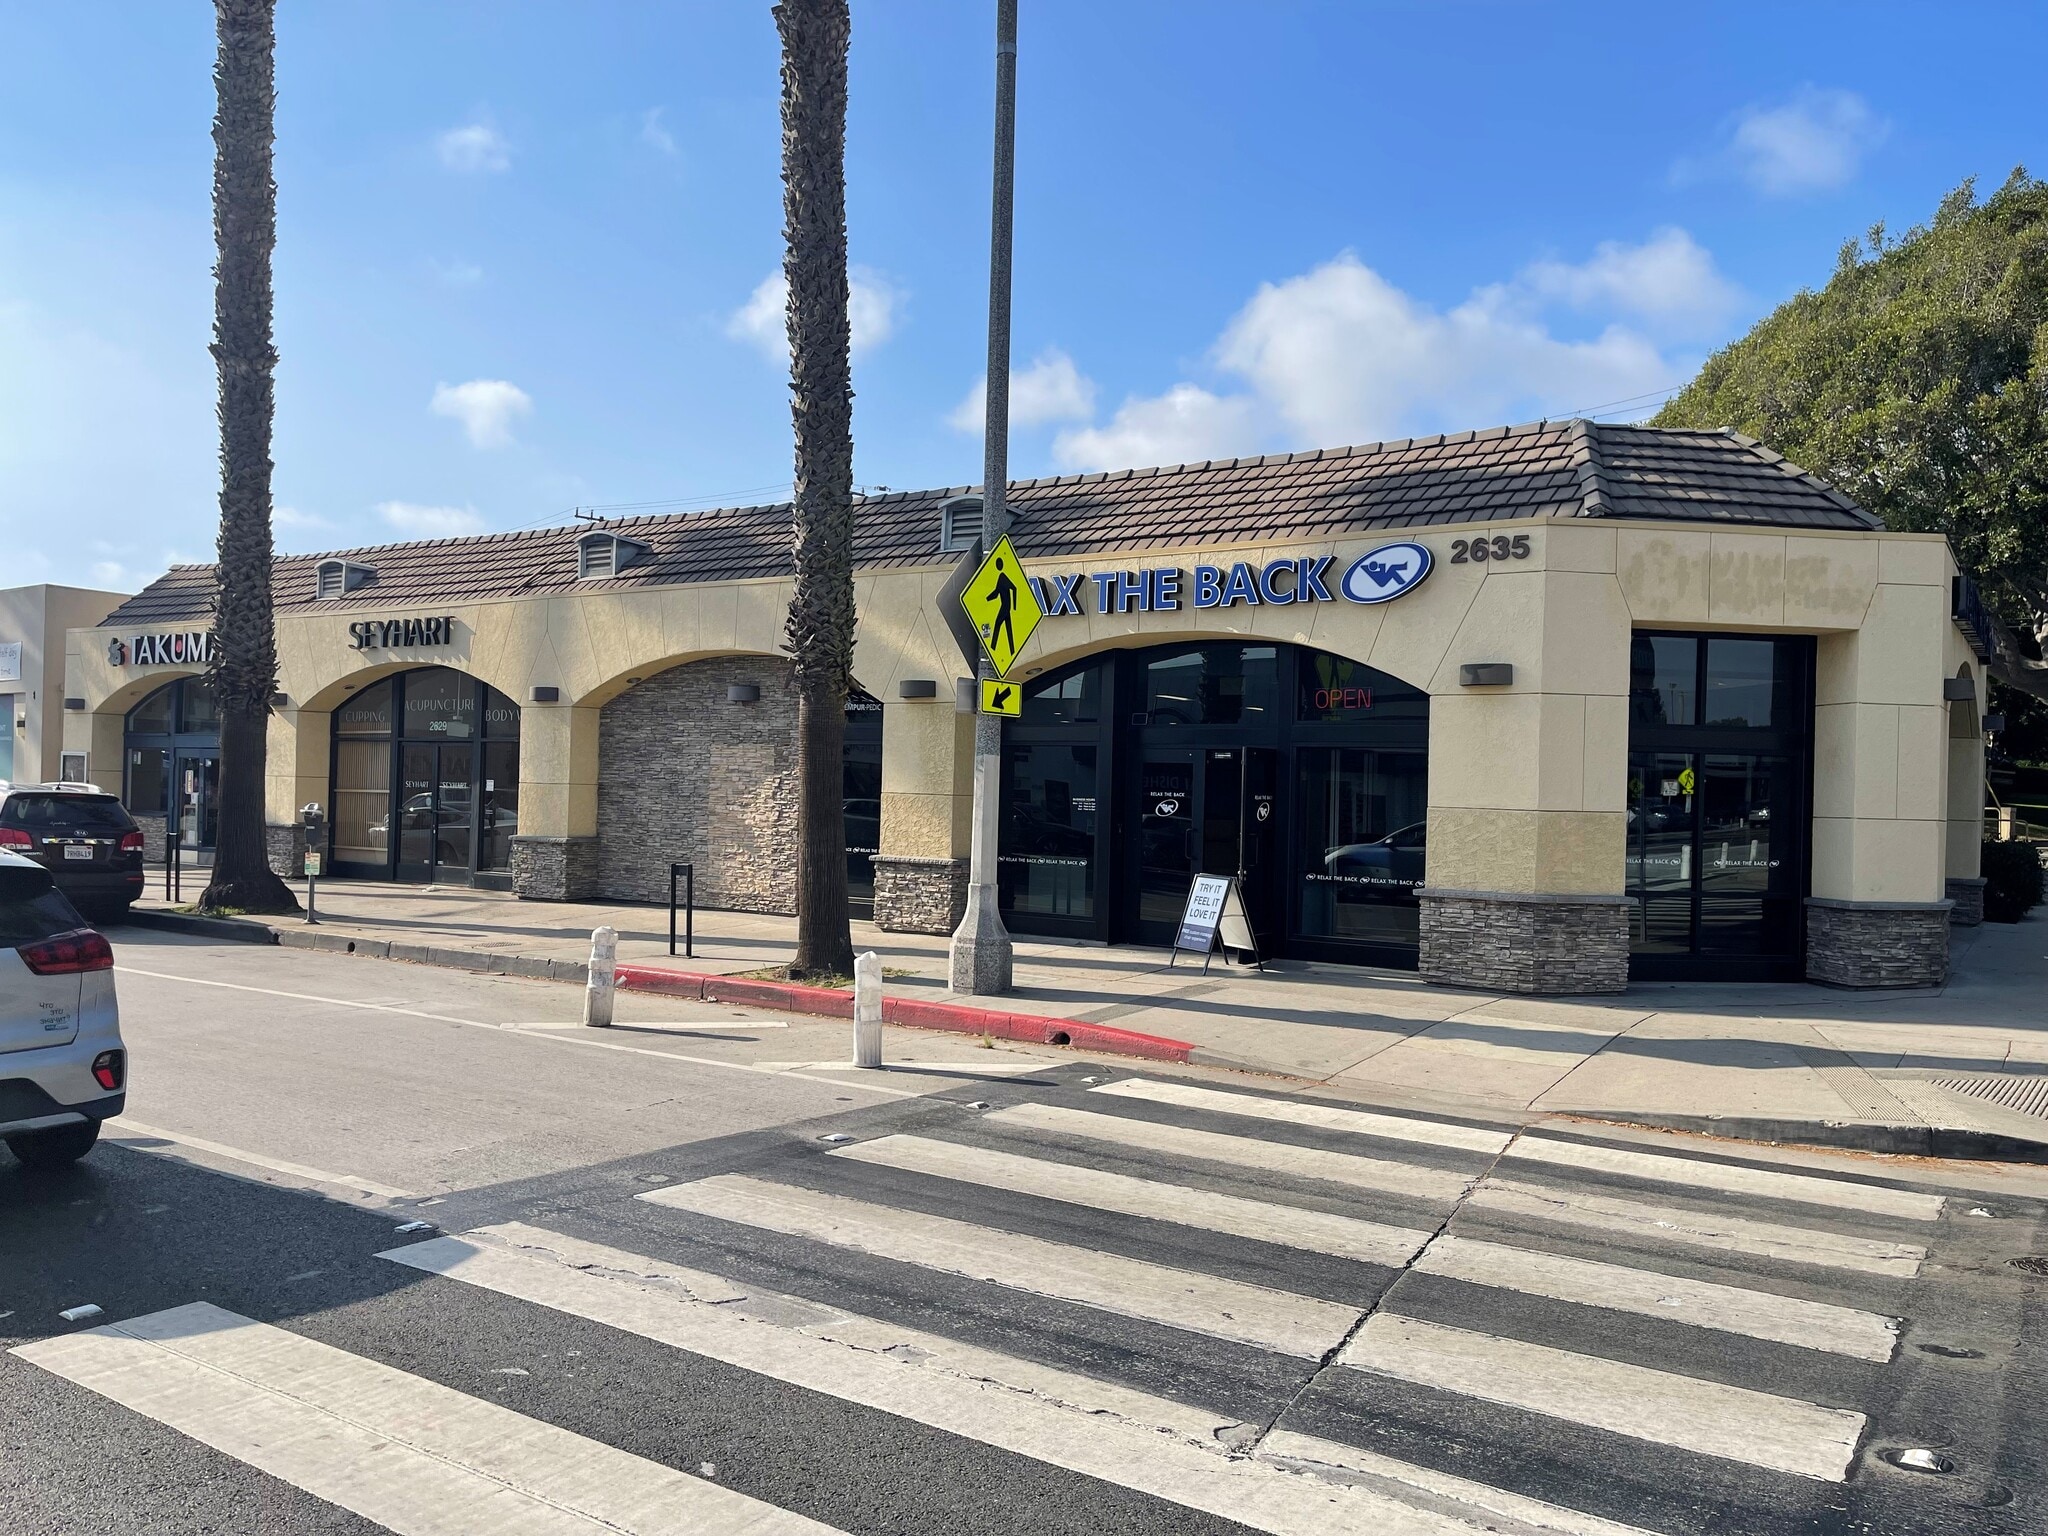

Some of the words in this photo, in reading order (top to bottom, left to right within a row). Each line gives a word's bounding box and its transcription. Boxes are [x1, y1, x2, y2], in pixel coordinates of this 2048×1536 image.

[1451, 534, 1531, 564] 2635
[1091, 566, 1181, 614] THE
[1193, 555, 1336, 608] BACK
[348, 615, 456, 650] SEYHART
[1315, 688, 1371, 709] OPEN
[345, 711, 385, 722] CUPPING
[429, 721, 447, 731] 2629
[1199, 883, 1214, 894] TRY
[1213, 885, 1223, 894] IT
[1193, 895, 1211, 906] FEEL
[1211, 898, 1221, 907] IT
[1189, 908, 1209, 919] LOVE
[1208, 911, 1217, 920] IT
